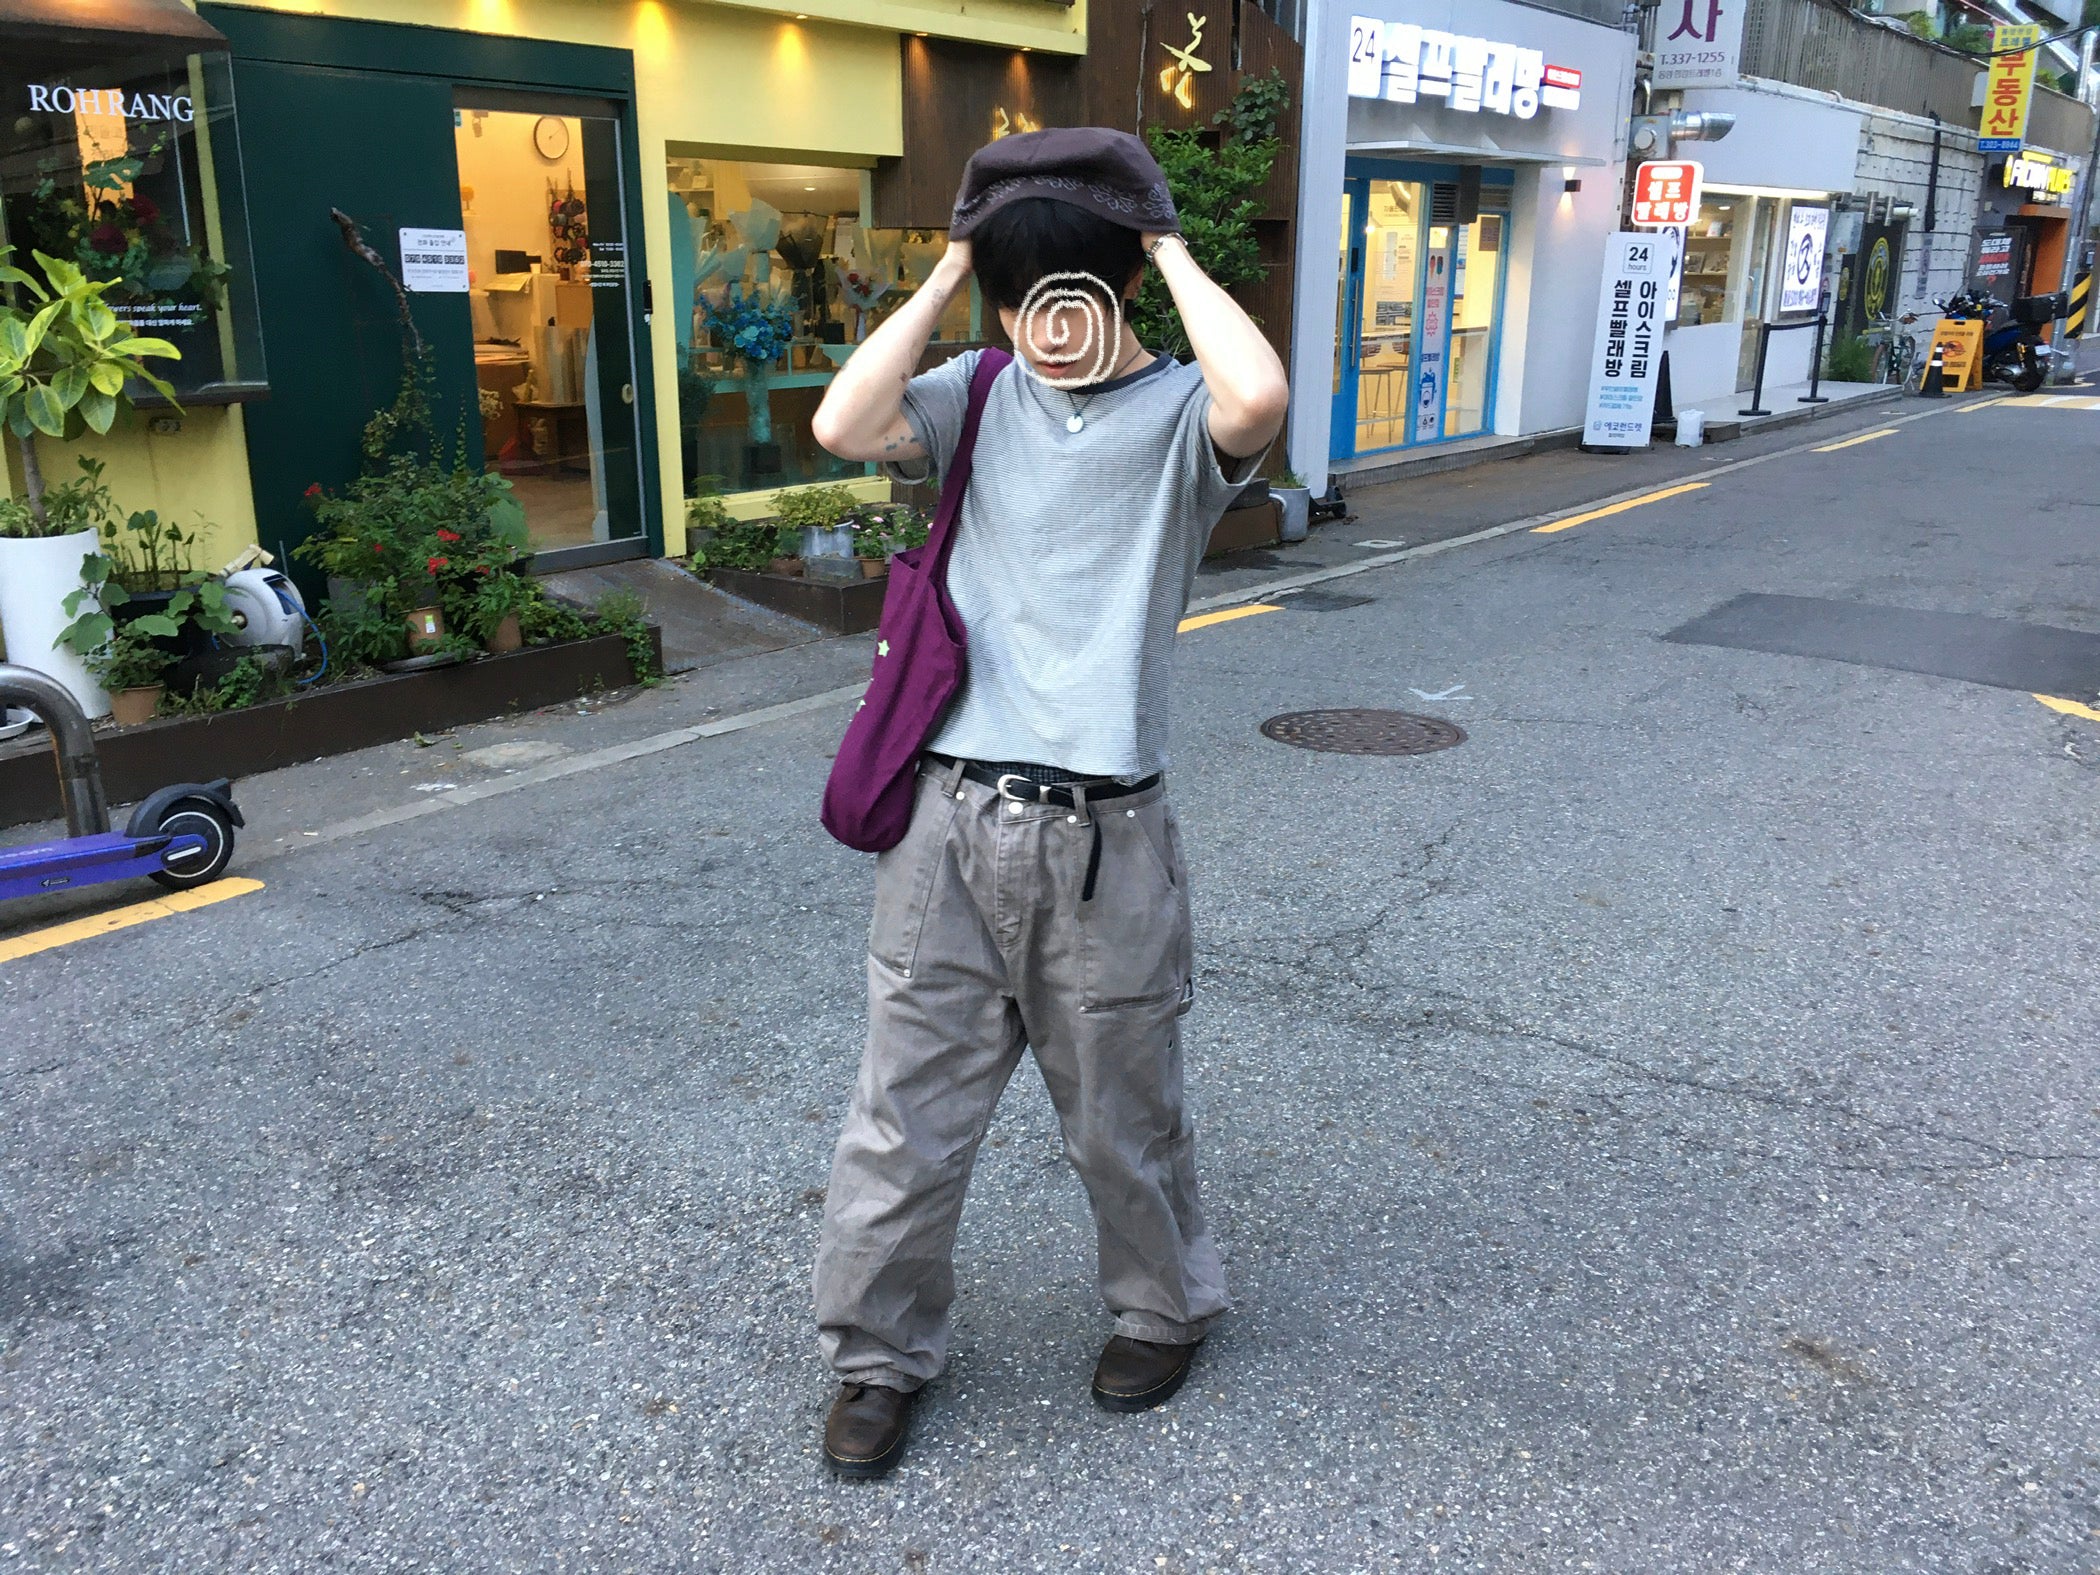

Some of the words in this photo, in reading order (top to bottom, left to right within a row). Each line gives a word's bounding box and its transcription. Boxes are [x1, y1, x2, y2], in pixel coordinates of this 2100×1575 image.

[1352, 27, 1376, 64] 24
[1381, 22, 1544, 120] 셀프빨래방
[1660, 51, 1726, 66] T.337-1255
[1988, 48, 2027, 136] 부동산
[1628, 246, 1649, 262] 24
[1604, 279, 1632, 378] 셀프빨래방
[1630, 281, 1658, 379] 아이스크림
